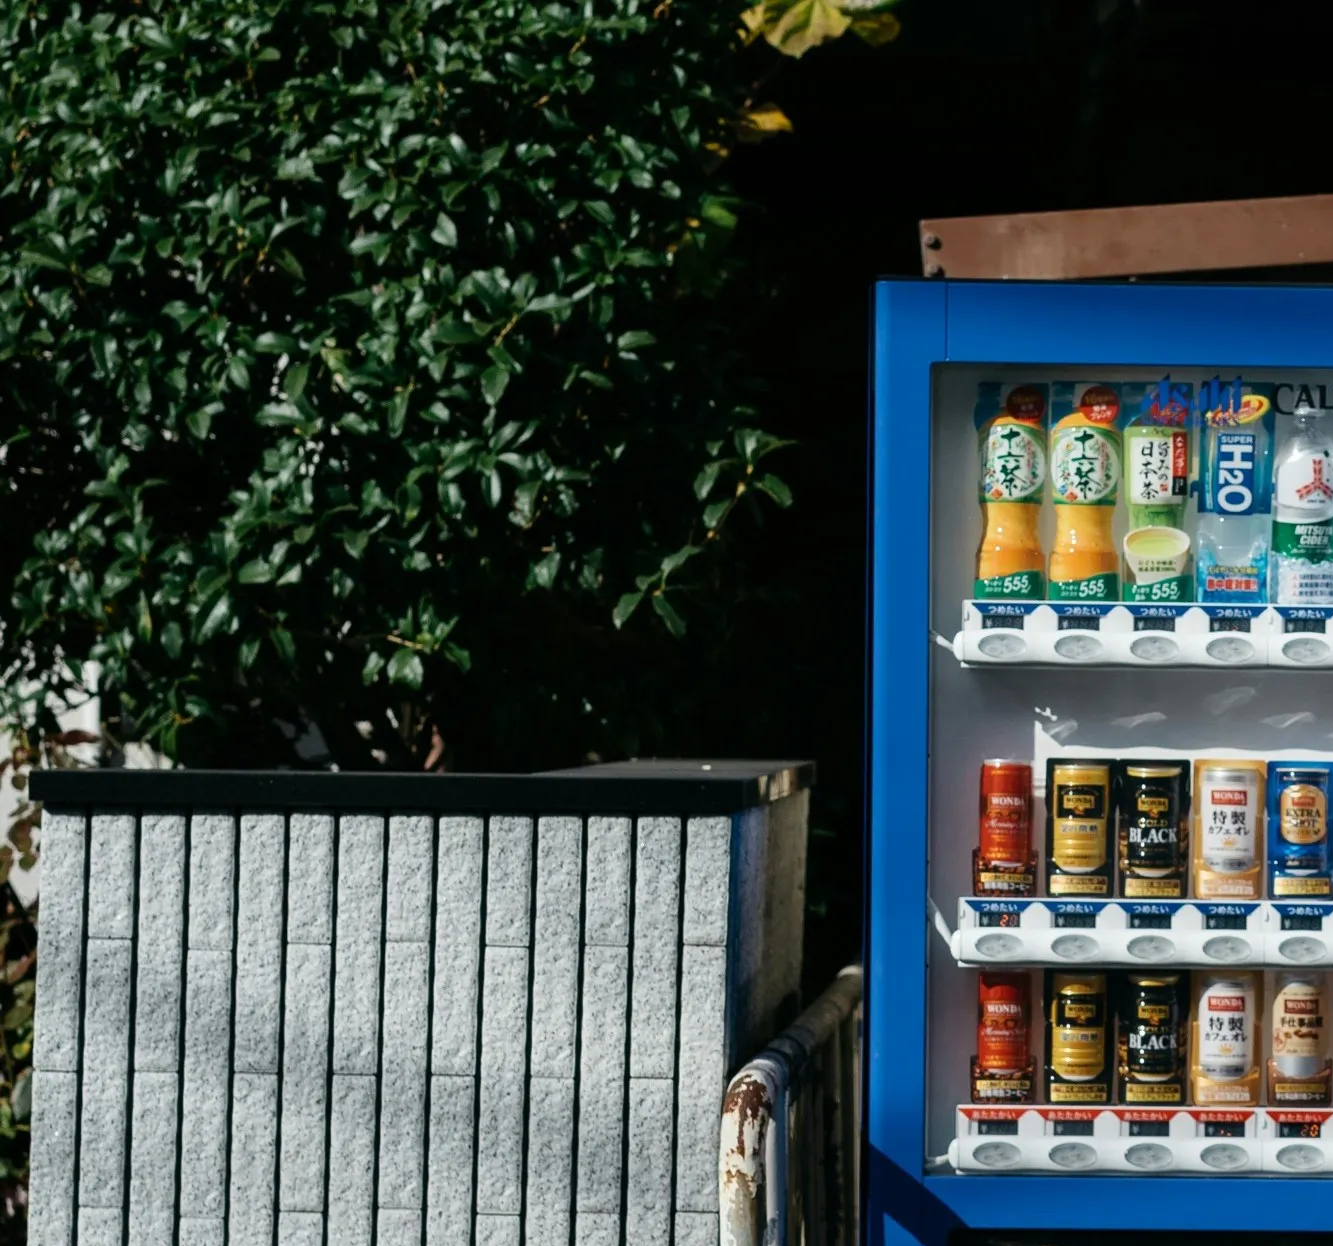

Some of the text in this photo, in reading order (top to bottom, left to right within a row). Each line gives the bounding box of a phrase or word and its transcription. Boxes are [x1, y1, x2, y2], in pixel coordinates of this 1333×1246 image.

[1220, 435, 1253, 444] SUPER
[997, 428, 1030, 498] 十六茶
[1071, 430, 1103, 500] 十六茶
[1140, 442, 1159, 499] 日本茶
[1218, 444, 1253, 513] H2O
[1300, 535, 1330, 546] CIDER
[989, 606, 1025, 616] つめたい
[1064, 607, 1100, 617] つめたい
[1141, 608, 1176, 617] つめたい
[1216, 609, 1251, 618] つめたい
[1289, 610, 1325, 619] つめたい
[1212, 810, 1247, 825] 特製
[1129, 827, 1178, 843] BLACK
[1208, 826, 1250, 836] カフェオレ
[982, 903, 1018, 913] つめたい
[1057, 904, 1093, 914] つめたい
[1134, 905, 1169, 914] つめたい
[1209, 906, 1245, 915] つめたい
[1288, 907, 1323, 916] つめたい
[1209, 1016, 1244, 1031] 特製
[1129, 1032, 1178, 1049] BLACK
[1205, 1032, 1248, 1043] カフェオレ
[972, 1111, 1016, 1120] あたたかい
[1048, 1112, 1092, 1121] あたたかい
[1123, 1112, 1167, 1121] あたたかい
[1199, 1113, 1243, 1122] あたたかい
[1278, 1114, 1322, 1123] あたたかい
